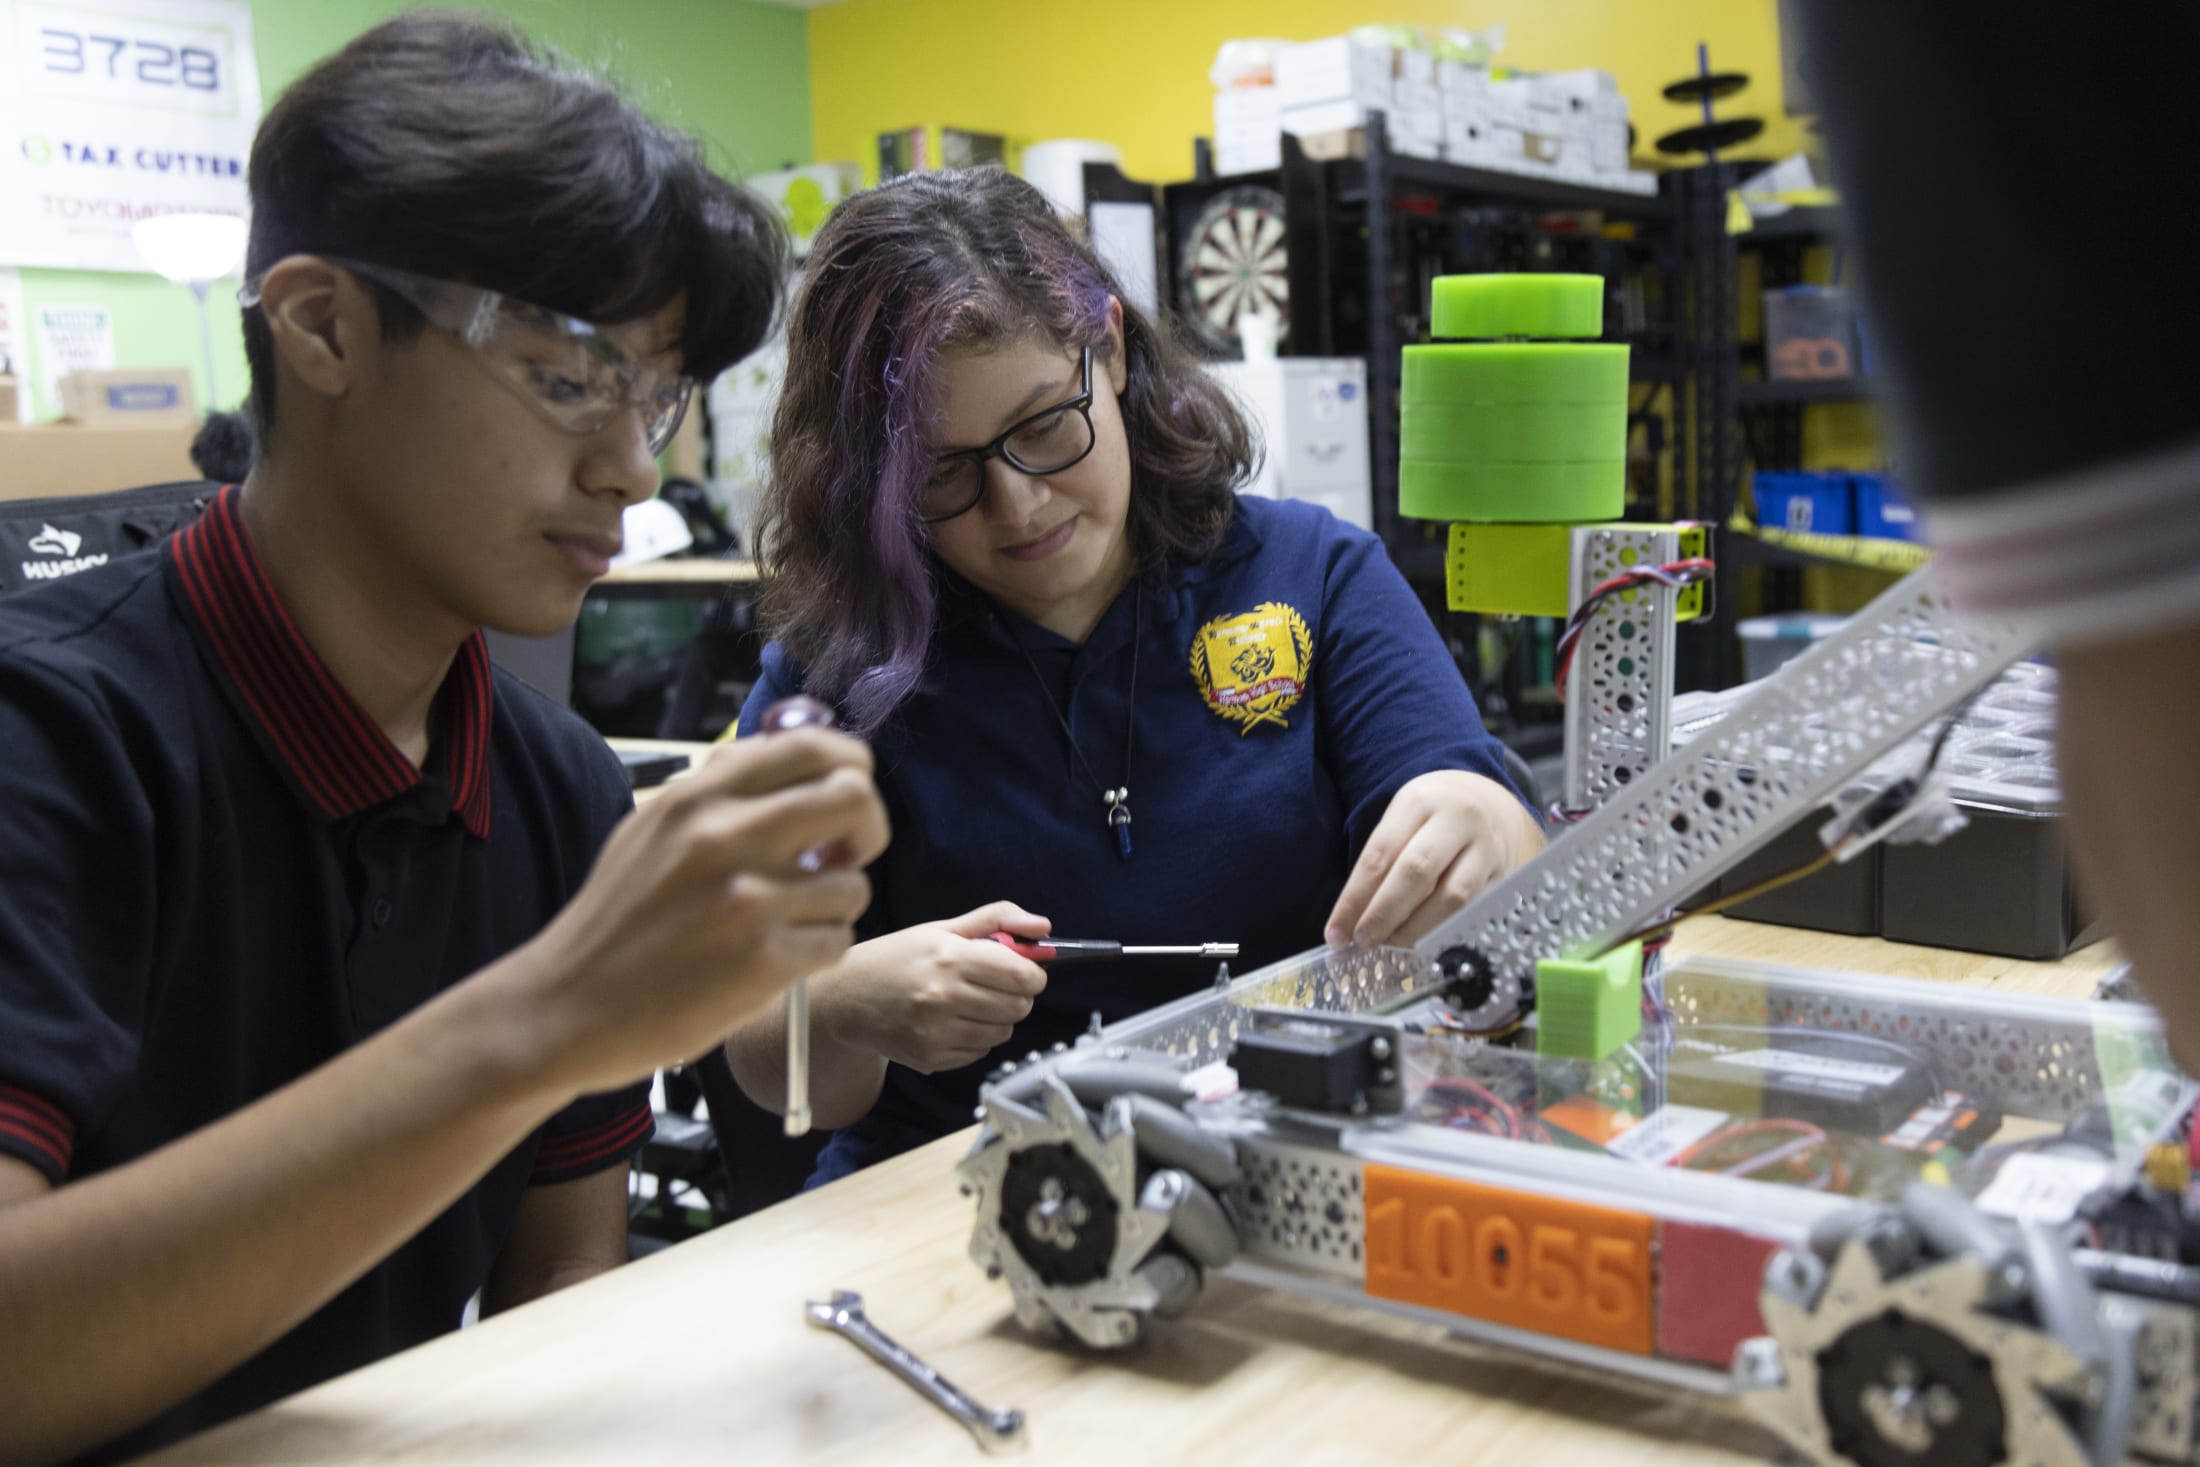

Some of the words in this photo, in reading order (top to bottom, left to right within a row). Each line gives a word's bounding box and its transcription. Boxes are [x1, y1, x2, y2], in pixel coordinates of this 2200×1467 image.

[41, 28, 218, 91] 3728
[61, 142, 120, 166] TAX
[1367, 1197, 1638, 1324] 10055
